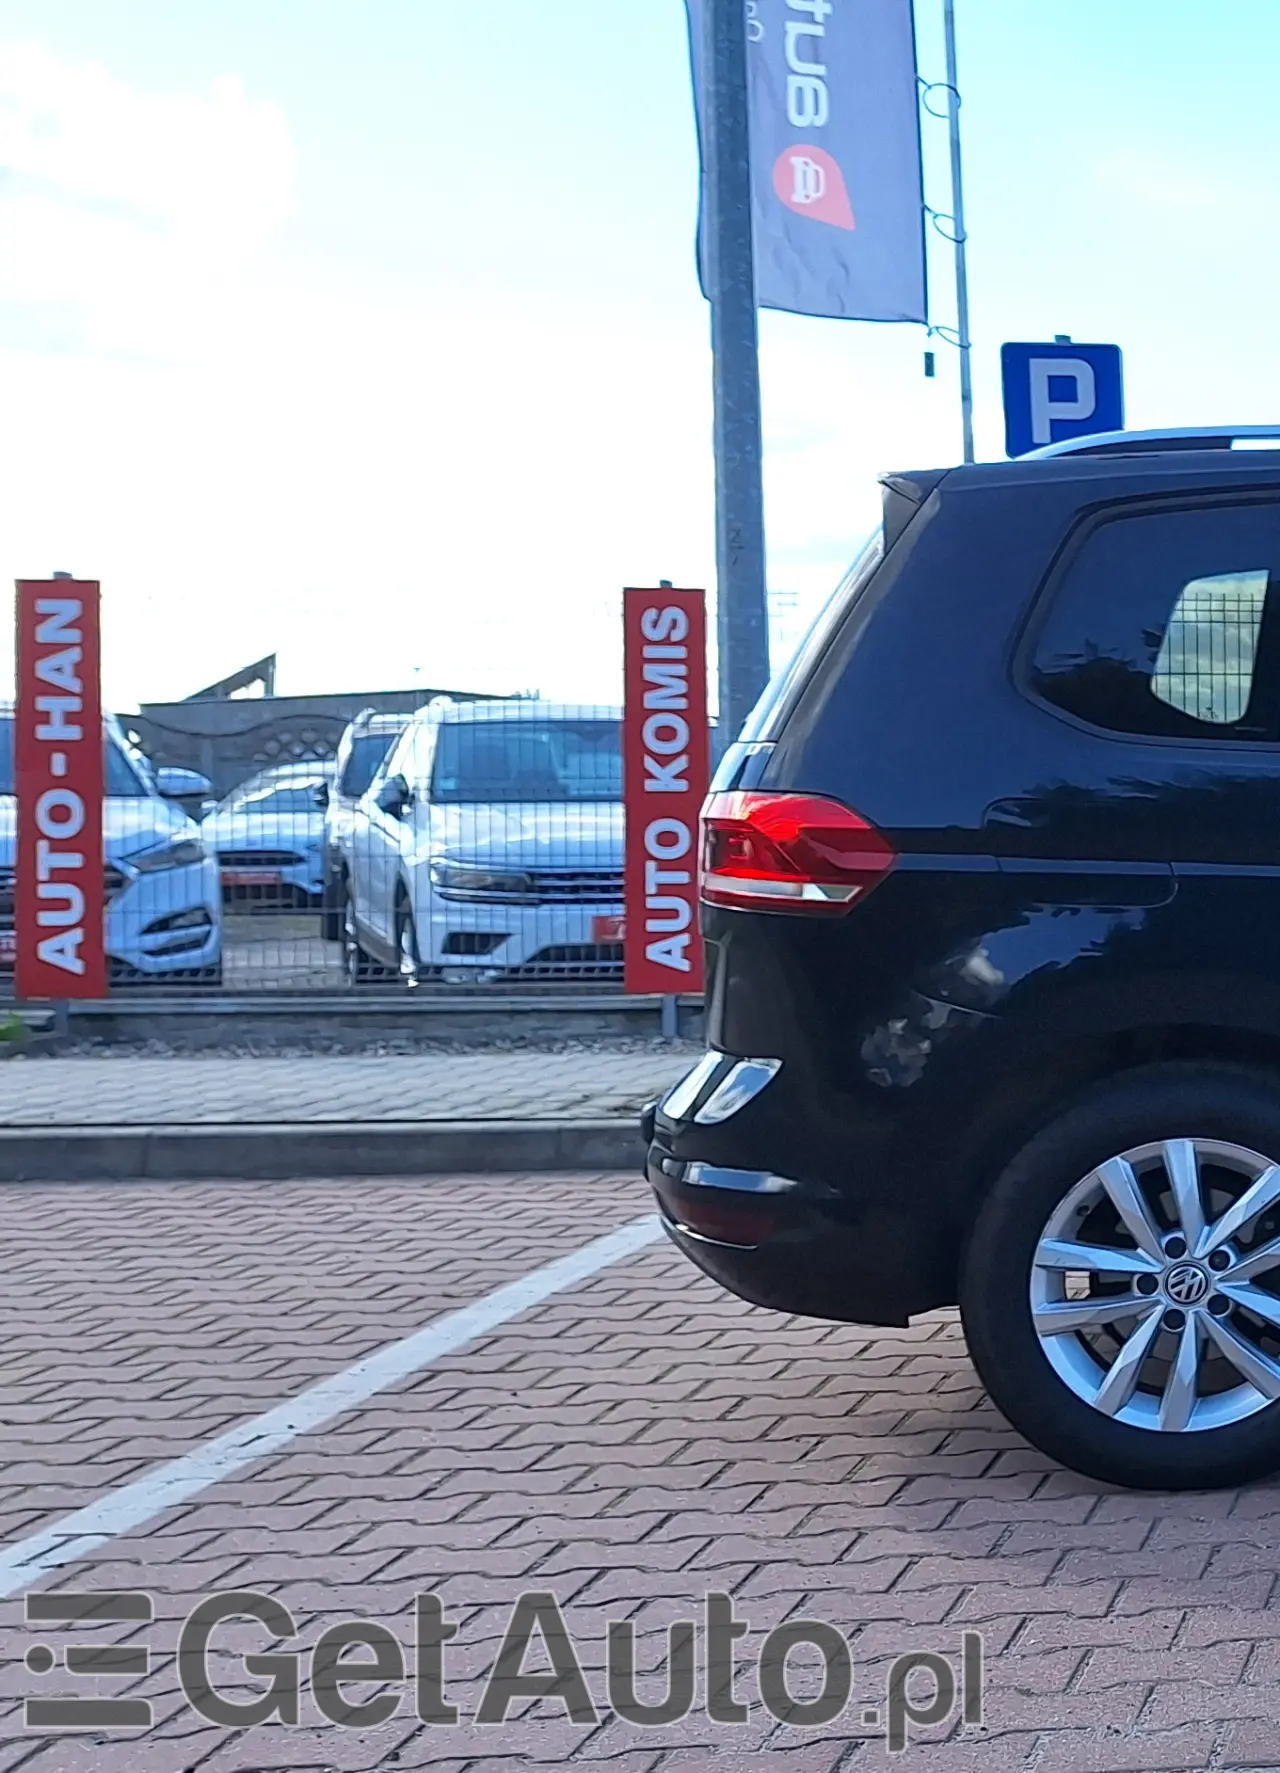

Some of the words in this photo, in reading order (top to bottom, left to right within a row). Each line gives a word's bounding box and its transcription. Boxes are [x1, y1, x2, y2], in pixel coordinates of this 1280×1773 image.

[1029, 358, 1095, 443] P
[641, 605, 690, 793] KOMIS
[644, 817, 692, 972] AUTO
